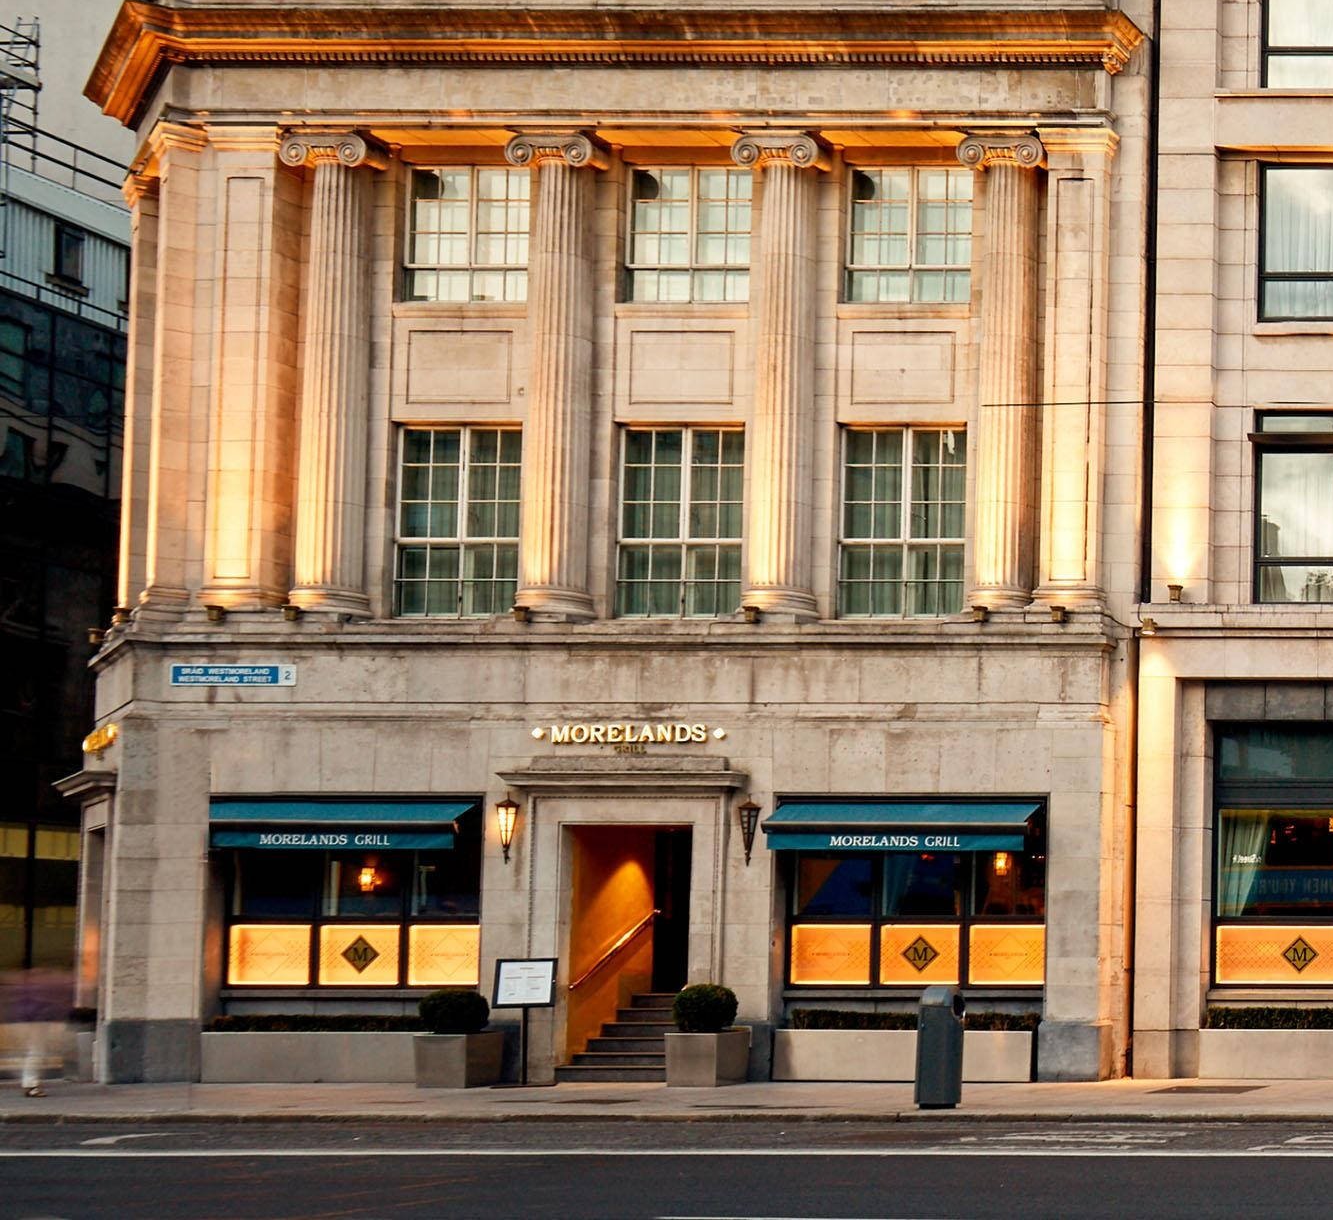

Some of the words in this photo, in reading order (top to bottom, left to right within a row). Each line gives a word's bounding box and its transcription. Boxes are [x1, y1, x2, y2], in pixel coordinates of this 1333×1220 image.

[284, 671, 291, 680] 2
[551, 724, 708, 744] MORELANDS
[613, 745, 648, 755] GRILL
[259, 834, 348, 845] MORELANDS
[354, 834, 390, 845] GRILL
[829, 836, 919, 847] MORELANDS
[924, 836, 960, 847] GRILL
[352, 947, 369, 961] M
[913, 947, 928, 961] M
[1292, 947, 1309, 962] M
